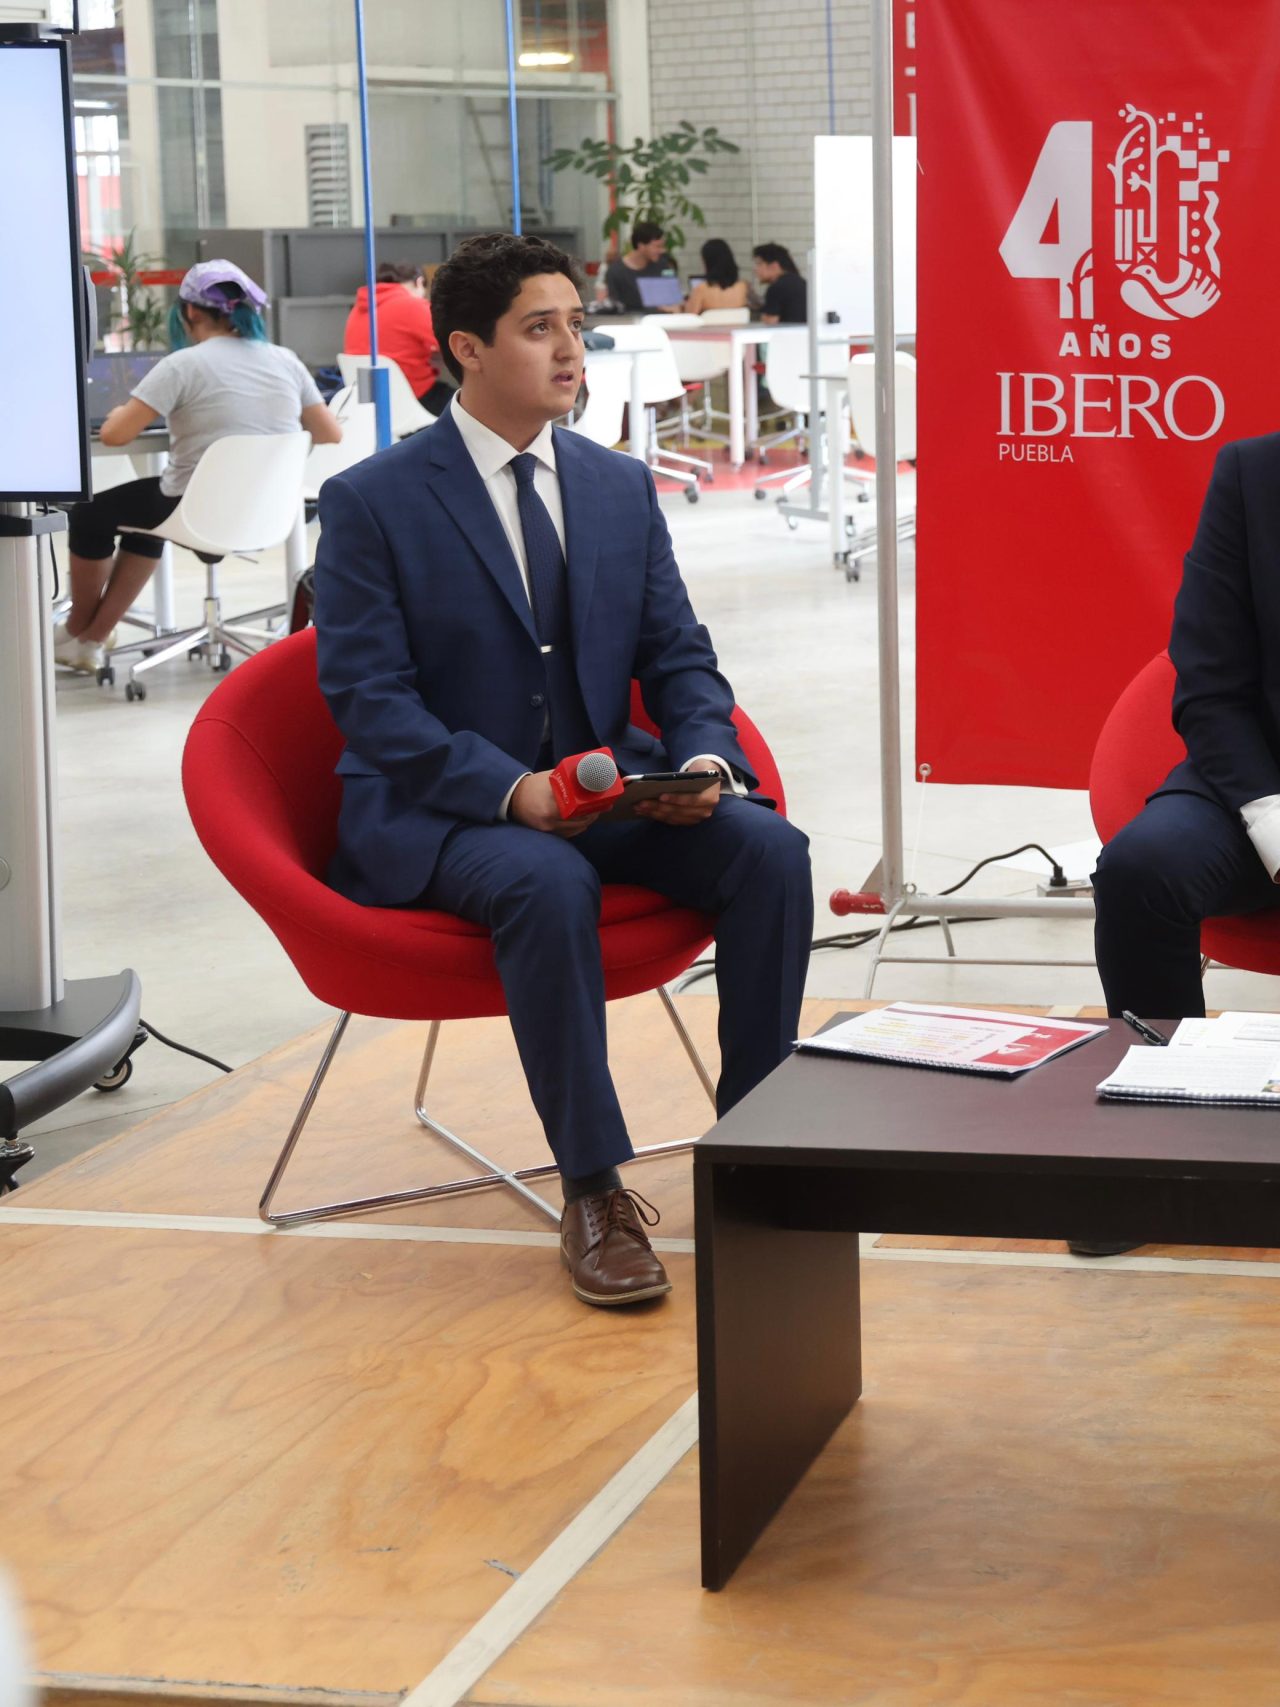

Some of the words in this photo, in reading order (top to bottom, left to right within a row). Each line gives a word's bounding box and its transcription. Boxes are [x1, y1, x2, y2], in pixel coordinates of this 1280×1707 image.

[999, 104, 1229, 320] 40
[1059, 324, 1171, 360] AÑOS
[996, 372, 1226, 441] IBERO
[999, 444, 1073, 463] PUEBLA
